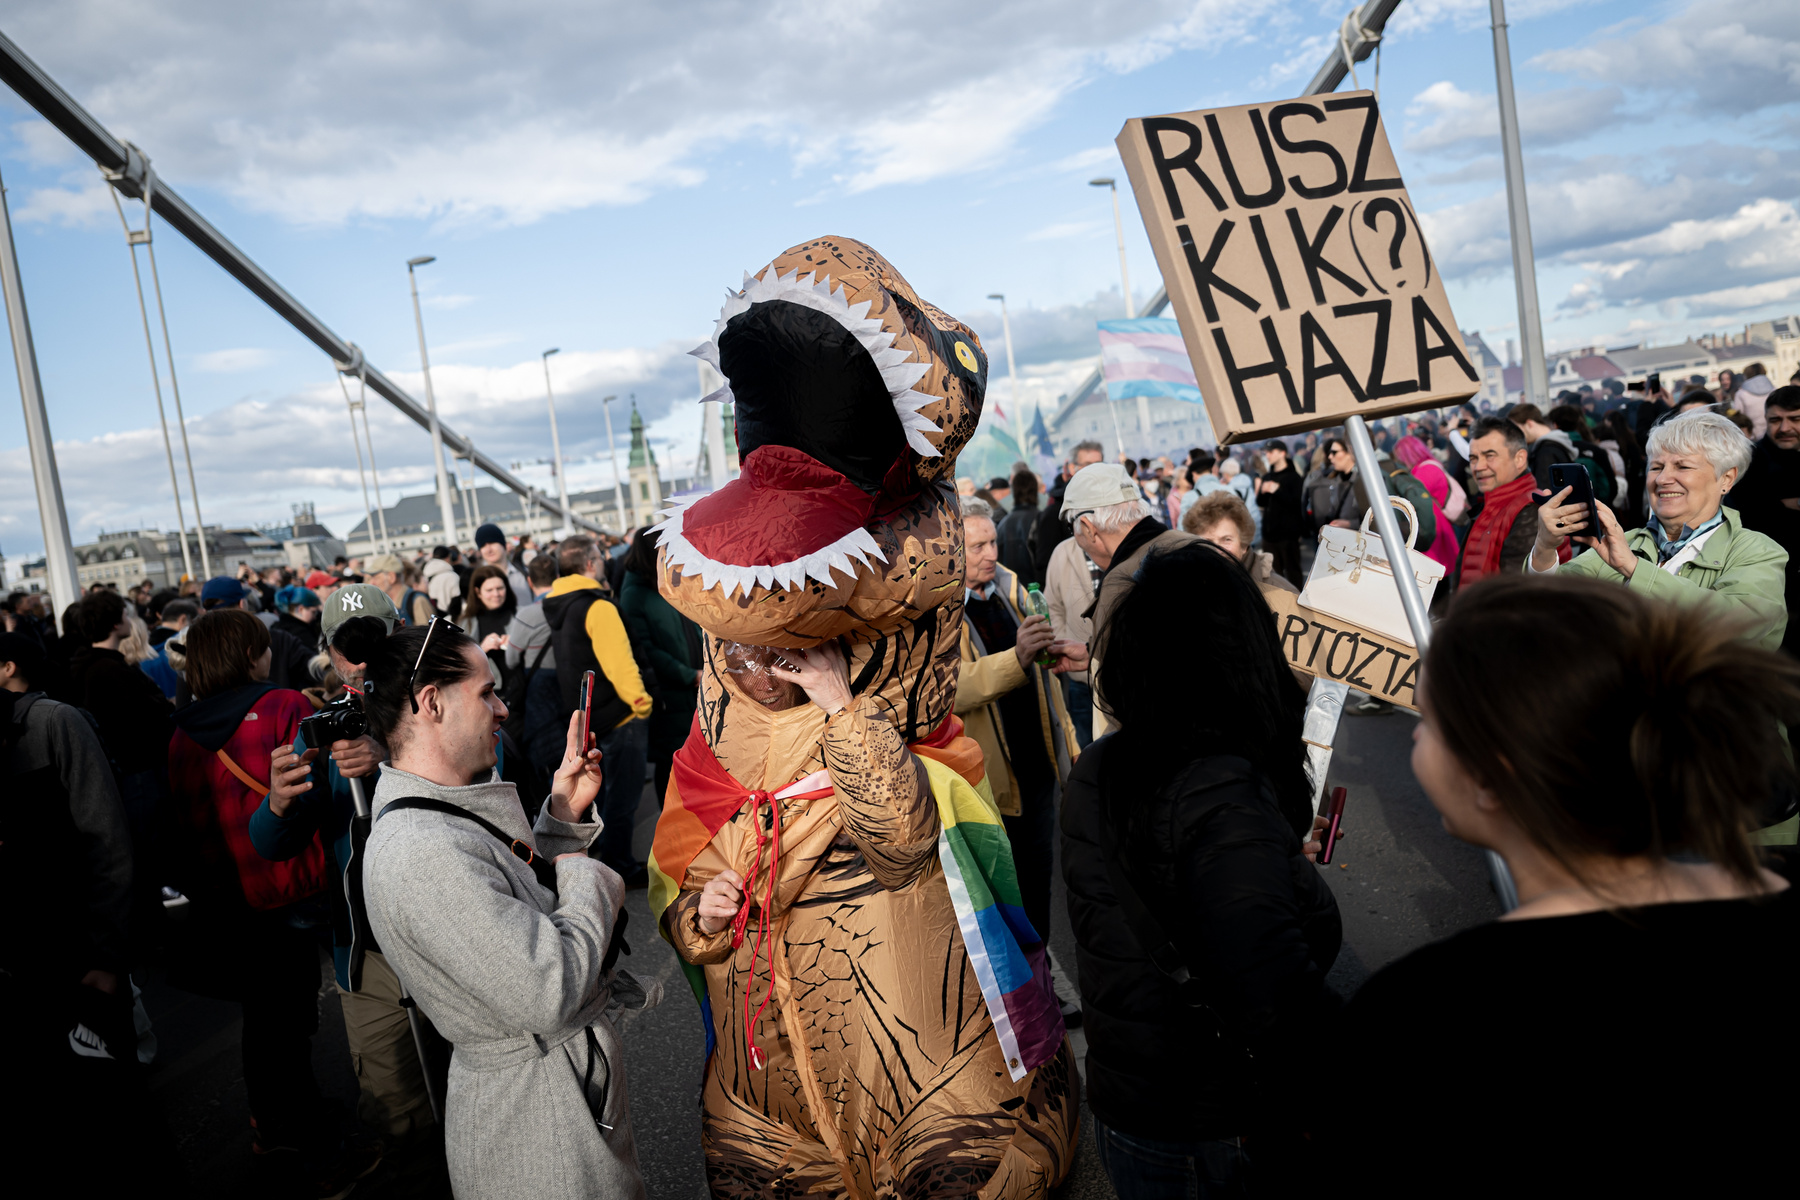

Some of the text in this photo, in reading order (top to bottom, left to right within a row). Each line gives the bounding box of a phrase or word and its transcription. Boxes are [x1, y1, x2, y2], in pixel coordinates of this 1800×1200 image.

[1142, 96, 1405, 220] RUSZ
[1176, 197, 1430, 323] KIK(?)
[1211, 295, 1480, 423] HAZA
[341, 591, 364, 612] NY
